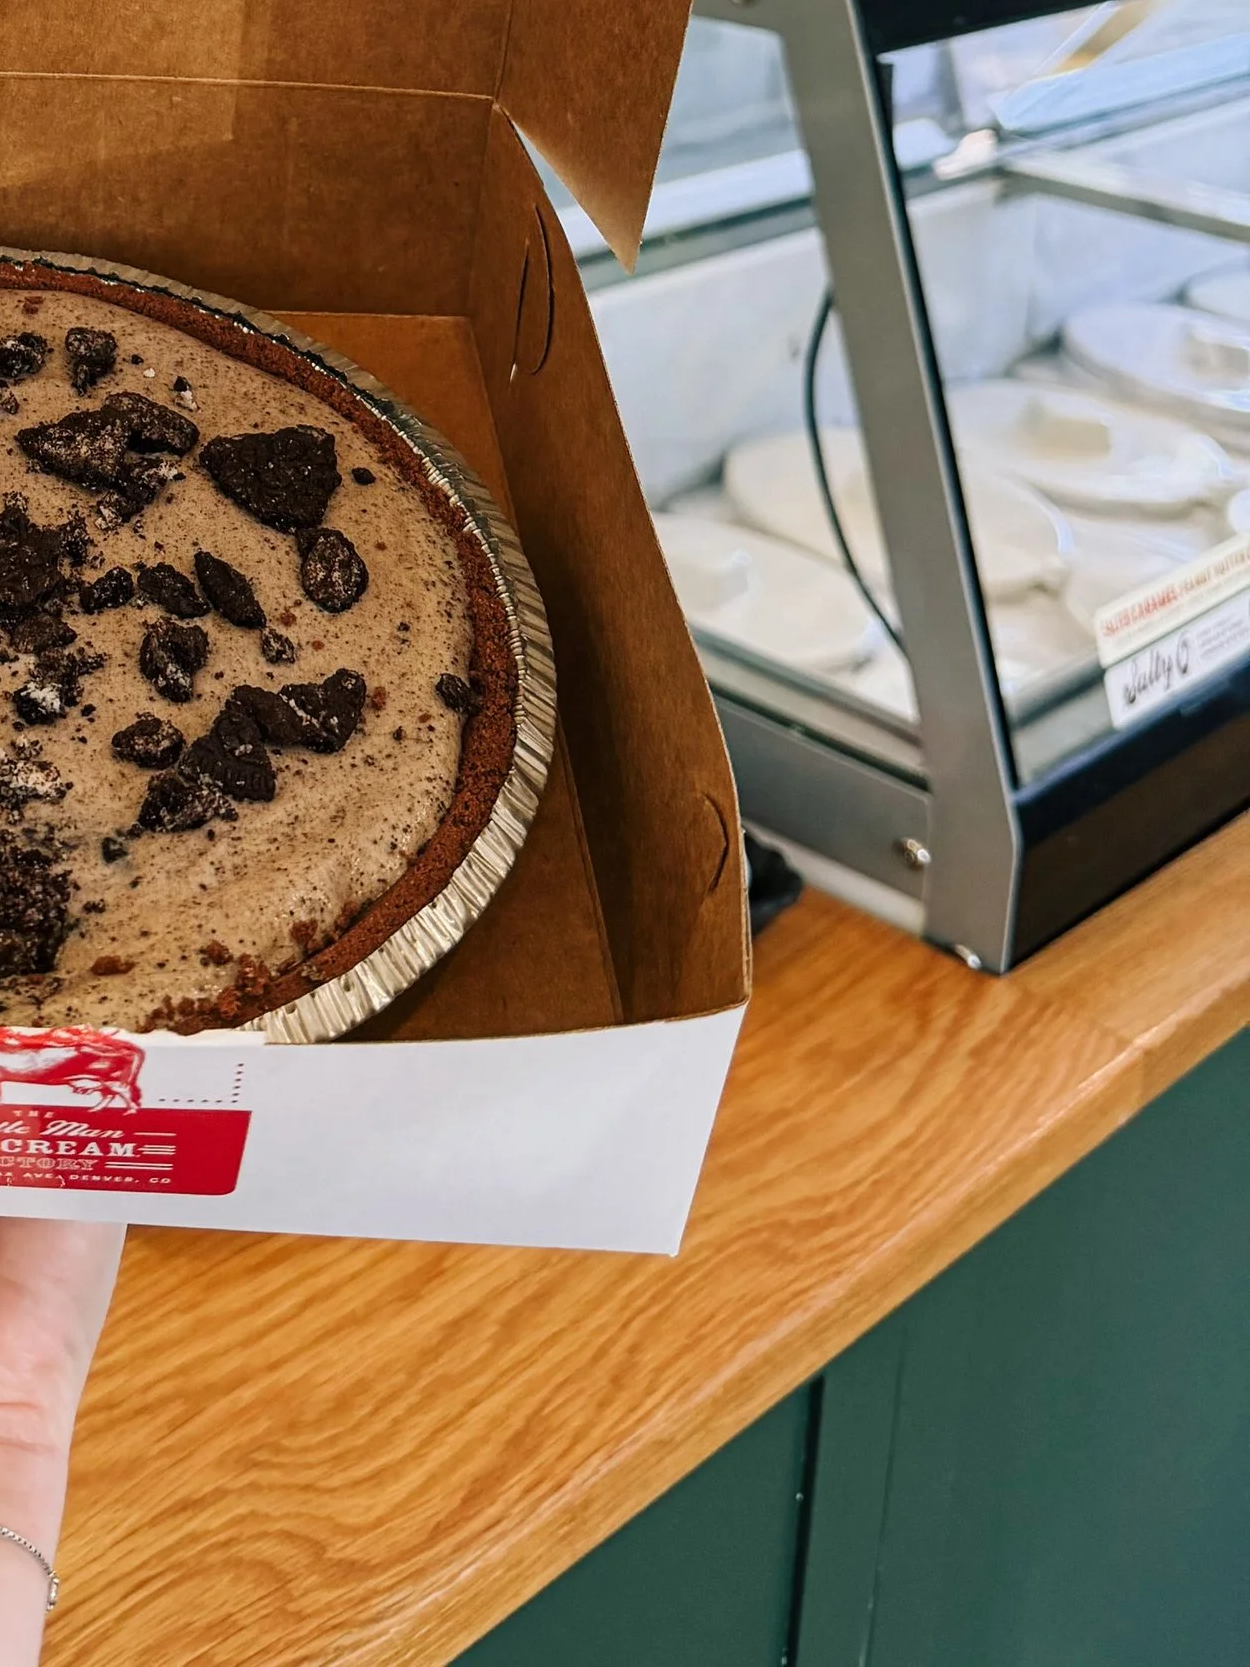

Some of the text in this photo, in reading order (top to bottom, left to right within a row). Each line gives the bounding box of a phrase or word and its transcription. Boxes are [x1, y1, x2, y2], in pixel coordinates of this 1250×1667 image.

[13, 1109, 54, 1118] THE
[39, 1119, 125, 1139] Man
[0, 1138, 138, 1158] CREAM
